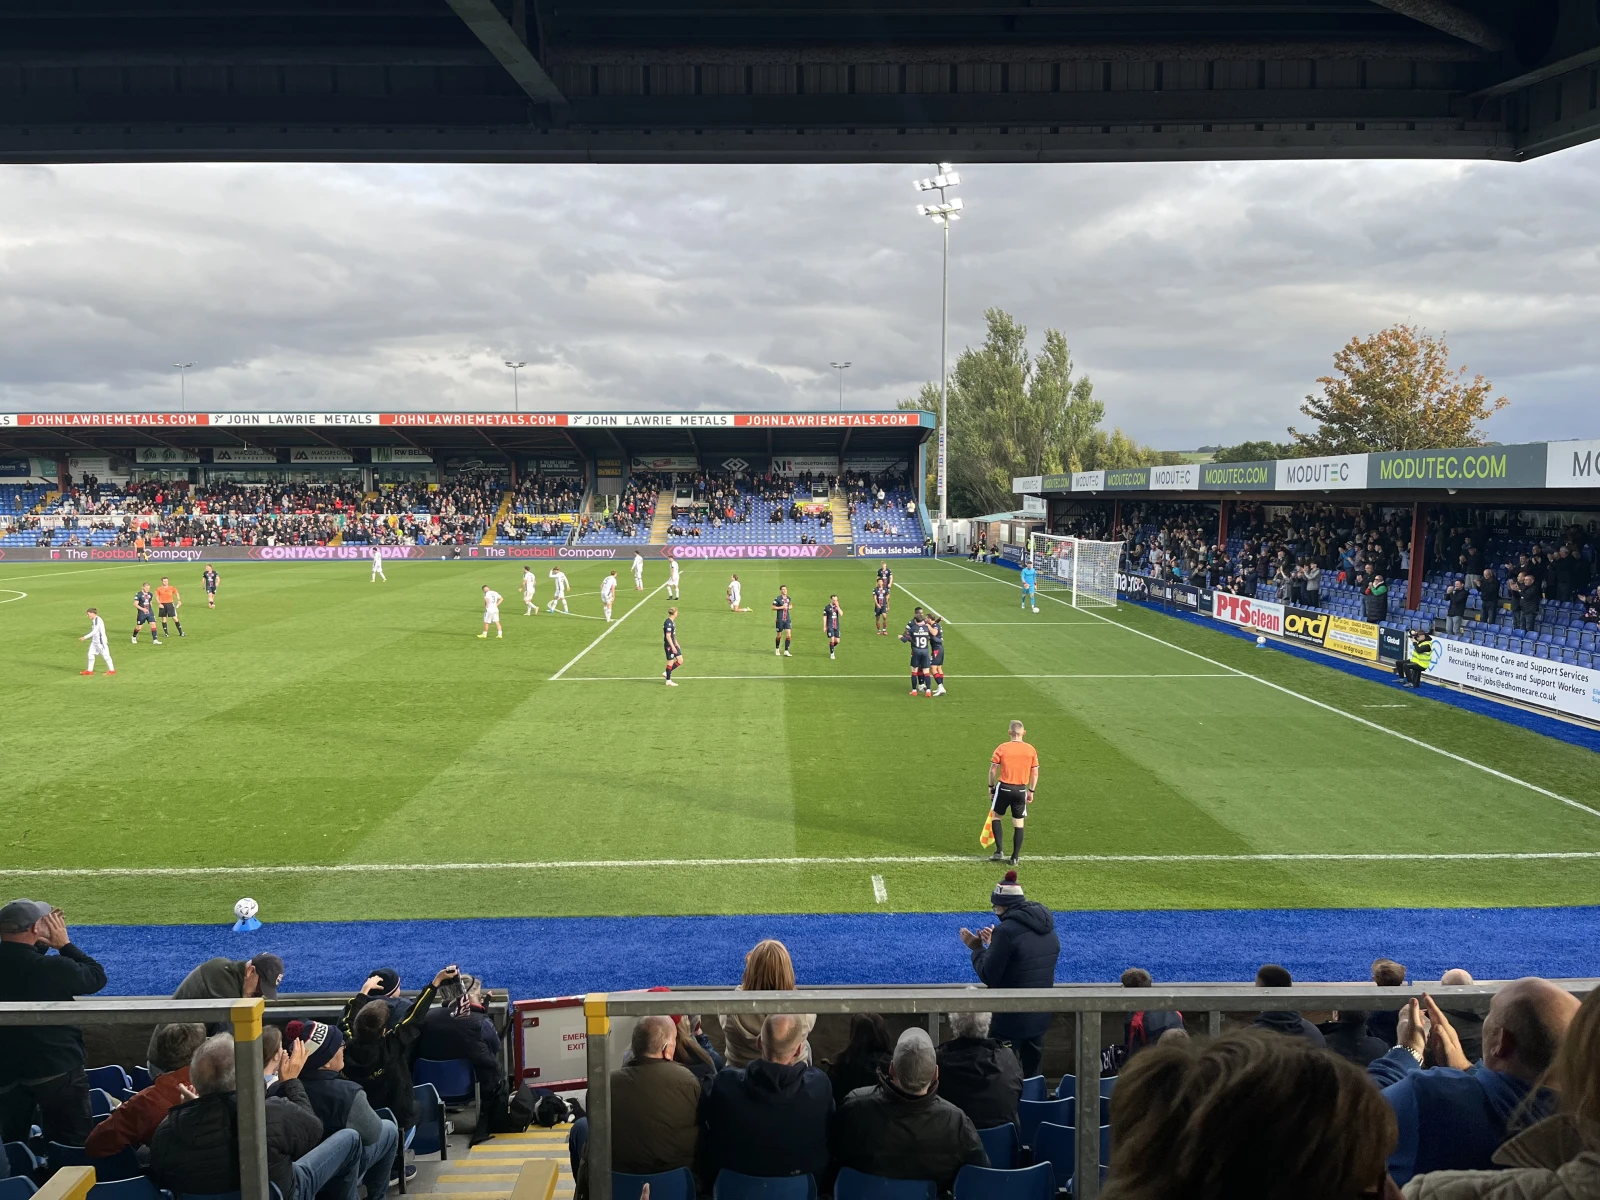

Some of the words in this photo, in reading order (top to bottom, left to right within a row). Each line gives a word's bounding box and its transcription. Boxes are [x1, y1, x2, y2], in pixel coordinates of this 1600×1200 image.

[30, 415, 197, 425] JOHNLAWRIEMETALS.COM
[227, 415, 260, 424] JOHN
[268, 415, 316, 424] LAWRIE
[324, 415, 372, 424] METALS
[392, 415, 557, 425] JOHNLAWRIEMETALS.COM
[586, 416, 617, 425] JOHN
[626, 416, 672, 425] LAWRIE
[680, 416, 727, 425] METALS
[746, 415, 908, 426] JOHNLAWRIEMETALS.COM
[1287, 463, 1349, 484] MODUTEC
[1380, 454, 1507, 480] MODUTEC.COM
[1107, 473, 1147, 487] MODUTEC.COM
[1155, 470, 1191, 485] MODUTEC
[1205, 467, 1268, 484] MODUTEC.COM
[66, 549, 89, 559] The
[145, 549, 202, 561] Company
[261, 547, 341, 559] CONTACT
[343, 547, 359, 558] US
[360, 546, 412, 558] TODAY
[484, 547, 506, 557] The
[508, 546, 556, 557] Football
[558, 547, 616, 559] Company
[673, 546, 750, 558] CONTACT
[752, 546, 767, 557] US
[768, 545, 820, 557] TODAY
[865, 544, 887, 555] black
[888, 545, 902, 554] isle
[903, 544, 922, 554] beds
[1216, 593, 1251, 624] PTS
[1251, 608, 1280, 632] clean
[1285, 614, 1328, 639] ord
[916, 636, 928, 649] 19
[1447, 644, 1463, 655] Eilean
[1464, 647, 1480, 658] Dubh
[1481, 652, 1499, 664] Home
[1500, 655, 1515, 666] Care
[1516, 658, 1528, 669] and
[1530, 662, 1558, 677] Support
[1559, 666, 1589, 683] Services
[1448, 656, 1476, 671] Recruiting
[1476, 662, 1494, 674] Home
[1495, 666, 1514, 679] Carers
[1515, 669, 1527, 681] and
[1529, 672, 1556, 688] Support
[1558, 679, 1586, 696] Workers
[1466, 672, 1482, 683] Email:
[1483, 675, 1557, 702] jobs@edhomecare.co.uk
[310, 1023, 327, 1045] ROSS
[567, 1042, 586, 1051] EXIT
